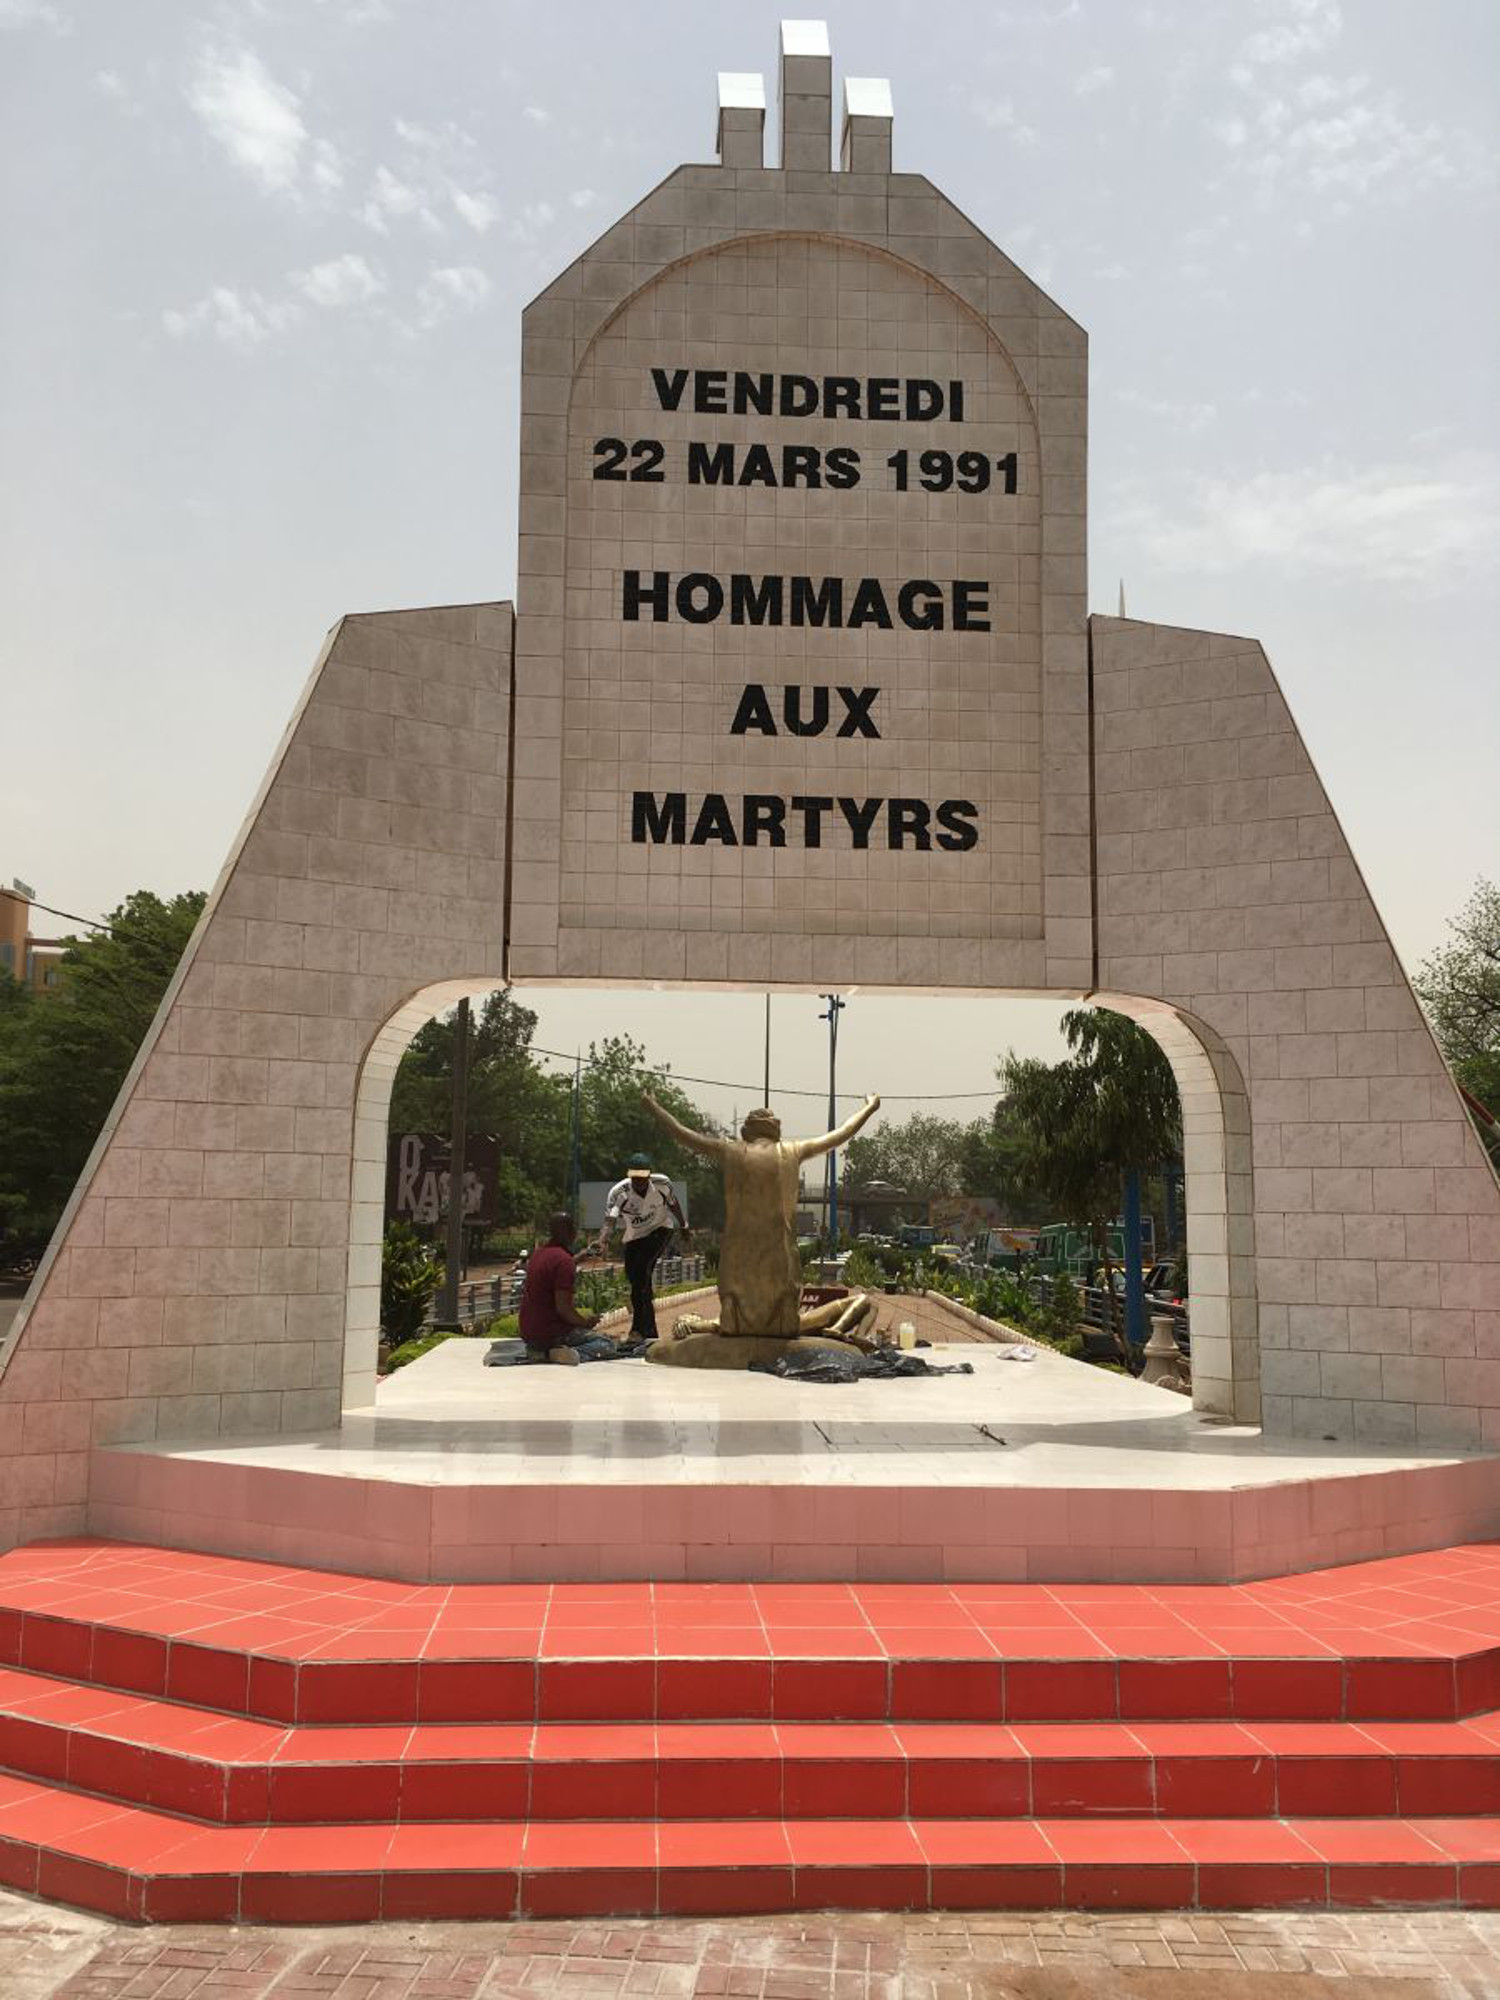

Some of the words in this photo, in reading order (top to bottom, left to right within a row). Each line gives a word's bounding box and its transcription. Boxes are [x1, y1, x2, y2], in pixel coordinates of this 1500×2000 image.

[651, 368, 963, 422] VENDREDI
[593, 438, 664, 482] 22
[688, 442, 860, 489] MARS
[888, 450, 1017, 494] 1991
[623, 570, 991, 632] HOMMAGE
[730, 685, 881, 739] AUX
[632, 792, 978, 851] MARTYRS
